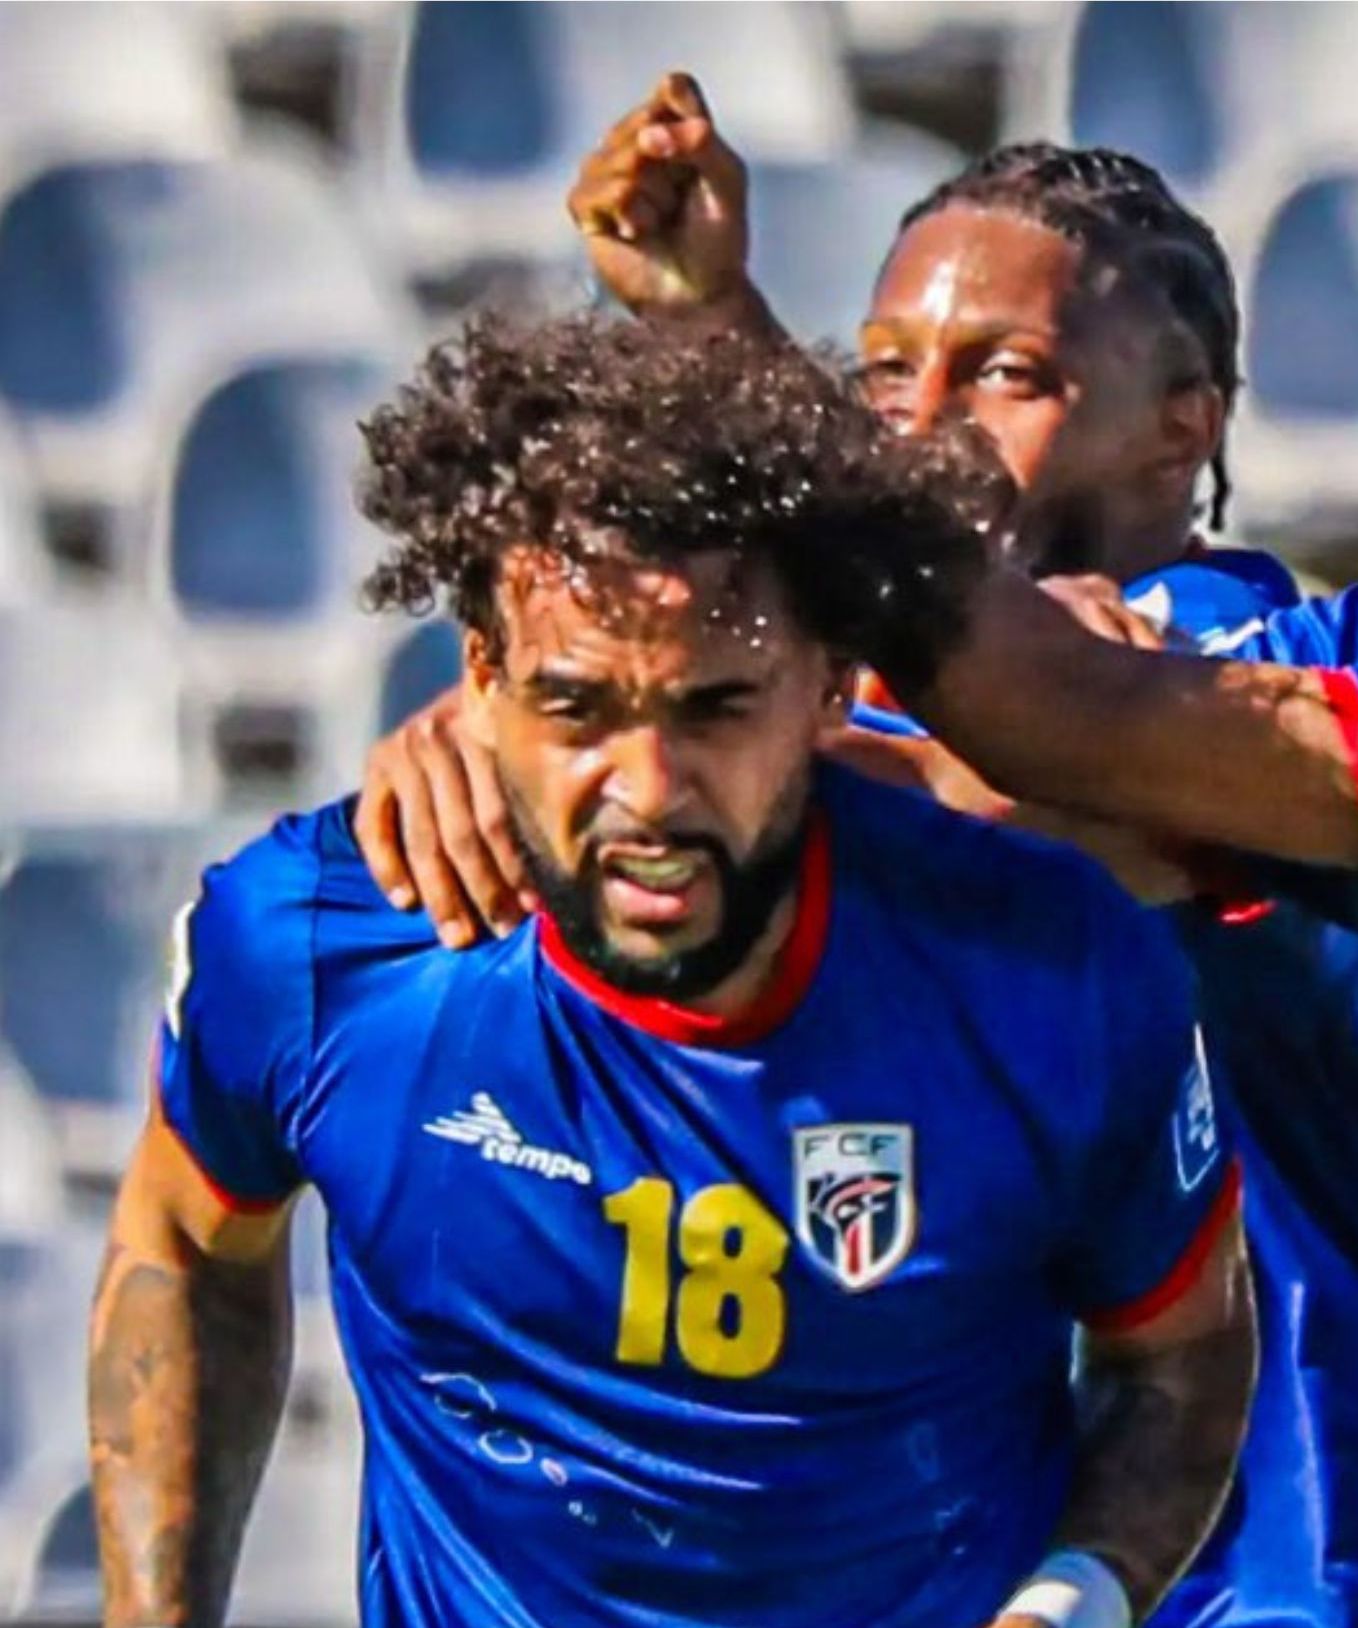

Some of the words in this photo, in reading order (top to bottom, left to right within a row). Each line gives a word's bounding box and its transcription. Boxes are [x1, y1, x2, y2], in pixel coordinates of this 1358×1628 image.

[481, 1137, 592, 1185] tempo
[804, 1132, 898, 1159] FCF
[604, 1177, 790, 1378] 18
